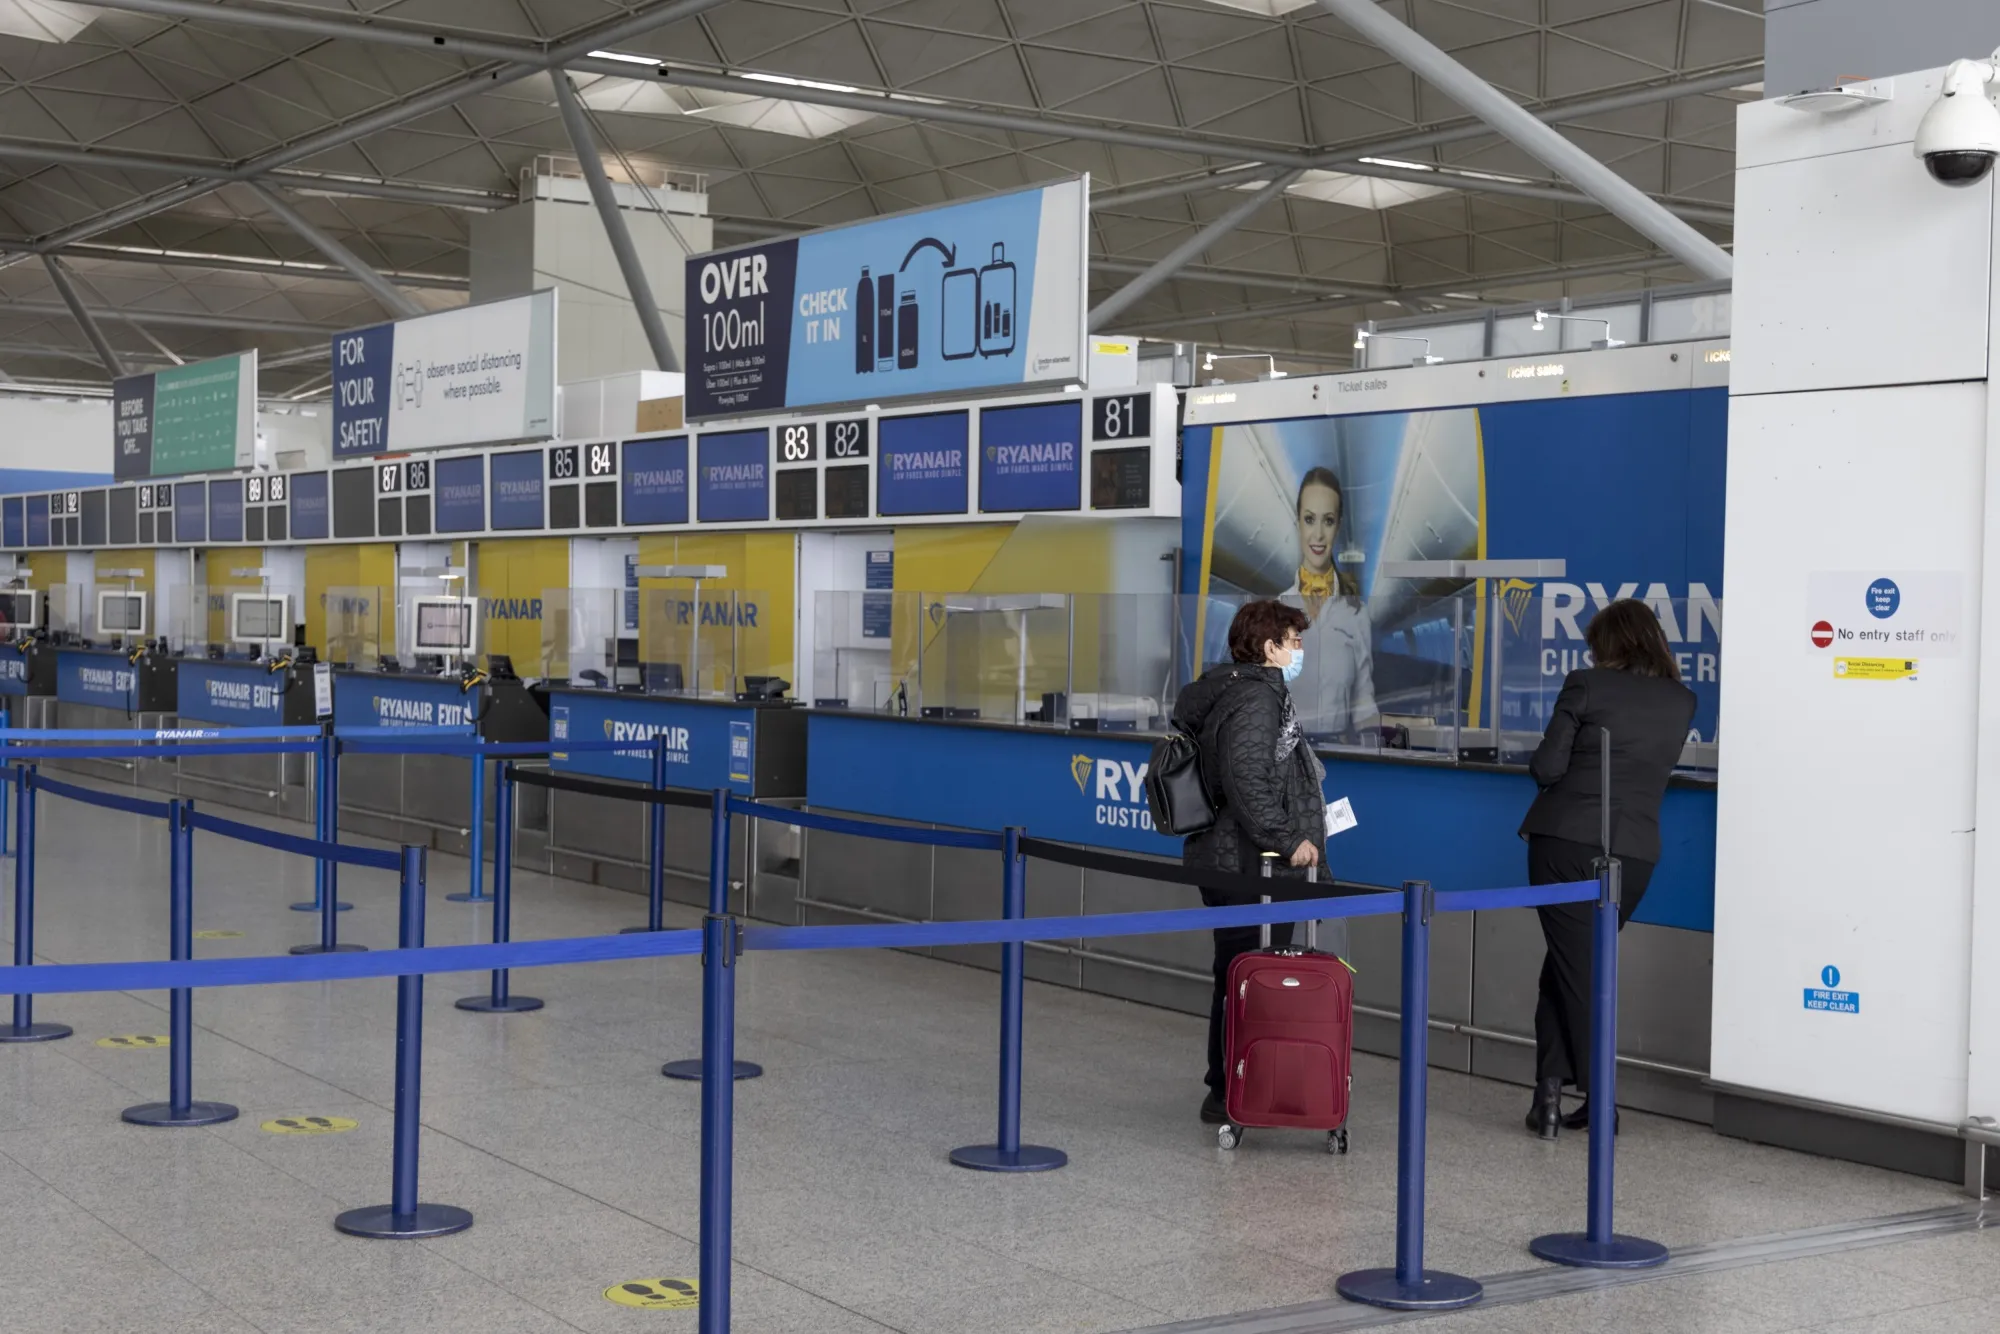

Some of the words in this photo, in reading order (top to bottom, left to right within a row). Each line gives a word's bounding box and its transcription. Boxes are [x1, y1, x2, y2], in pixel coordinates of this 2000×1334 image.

[700, 254, 769, 304] OVER
[800, 288, 848, 317] CHECK
[703, 301, 764, 352] 100ml
[807, 321, 819, 344] IT
[823, 317, 840, 341] IN
[340, 336, 365, 366] FOR
[427, 361, 455, 379] observe
[457, 353, 479, 374] social
[481, 349, 521, 370] distancing
[1537, 364, 1564, 376] sales
[339, 377, 374, 407] YOUR
[443, 382, 467, 398] where
[1338, 381, 1362, 393] Ticket
[1364, 379, 1387, 391] sales
[121, 398, 143, 417] BEFORE
[1104, 397, 1134, 437] 81
[117, 420, 131, 435] YOU
[132, 417, 148, 434] TAKE
[340, 417, 382, 449] SAFETY
[784, 425, 809, 461] 83
[834, 422, 860, 457] 82
[555, 449, 573, 477] 85
[591, 445, 611, 474] 84
[893, 450, 962, 471] RYANAIR
[996, 442, 1073, 464] RYANAIR
[382, 466, 397, 492] 87
[410, 463, 425, 488] 86
[634, 469, 684, 487] RYANAIR
[710, 464, 764, 482] RYANAIR
[249, 478, 261, 501] 89
[271, 477, 283, 499] 88
[67, 493, 78, 512] 92
[1875, 596, 1891, 604] keep
[1838, 628, 1854, 640] No
[1859, 629, 1890, 643] entry
[1895, 629, 1925, 642] staff
[1930, 631, 1957, 644] only
[211, 680, 250, 700] RYANAIR
[254, 686, 272, 708] EXIT
[380, 697, 433, 721] RYANAIR
[438, 703, 462, 726] EXIT
[614, 721, 689, 751] RYANAIR
[1096, 758, 1149, 803] RY
[1096, 805, 1156, 831] CUSTO
[1807, 1000, 1828, 1009] KEEP
[1829, 1002, 1855, 1012] CLEAR
[1813, 990, 1830, 1000] FIRE
[1832, 992, 1849, 1001] EXIT
